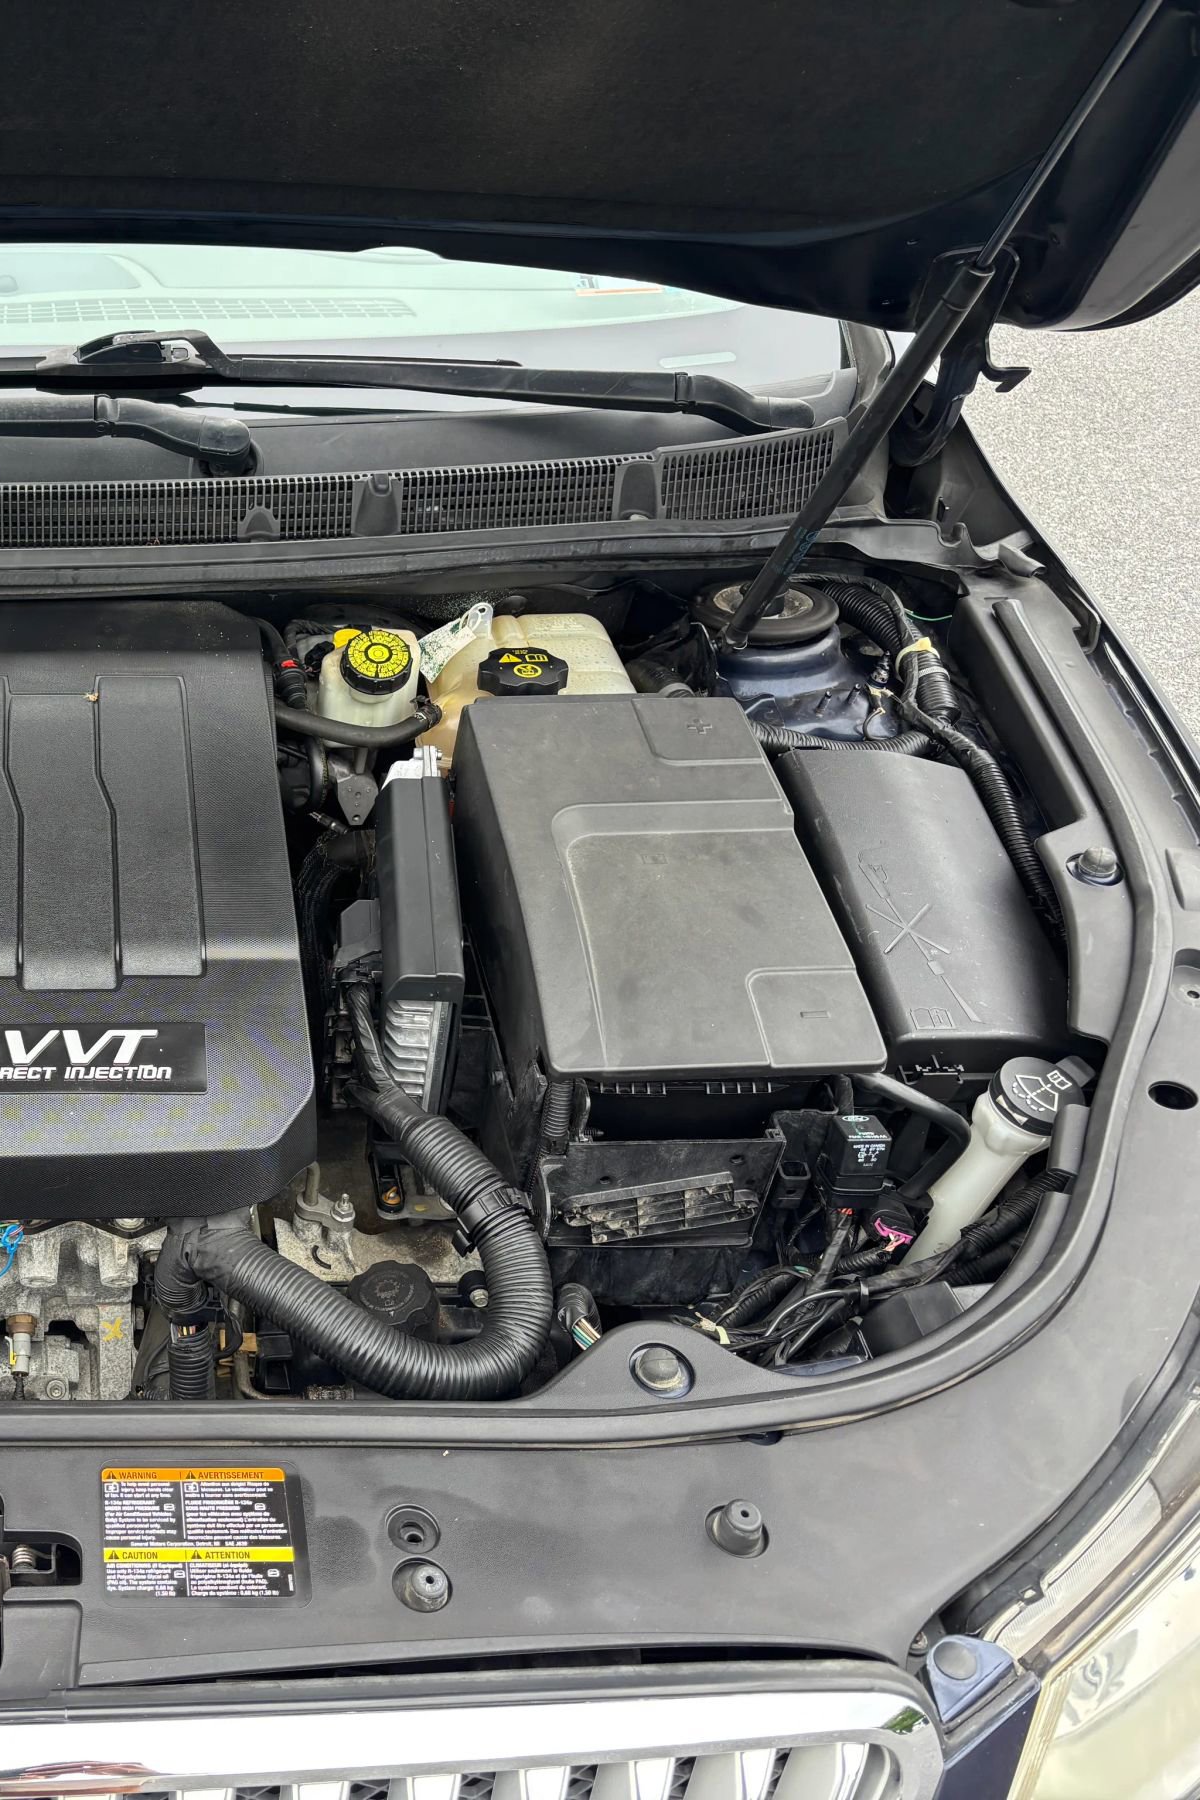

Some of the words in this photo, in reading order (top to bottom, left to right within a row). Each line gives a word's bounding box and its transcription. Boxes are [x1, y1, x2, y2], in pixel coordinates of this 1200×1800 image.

[4, 1029, 158, 1065] VVT
[119, 1471, 157, 1479] WARNING
[198, 1471, 264, 1479] AVERTISSEMENT
[122, 1551, 158, 1559] CAUTION
[205, 1551, 250, 1559] ATTENTION
